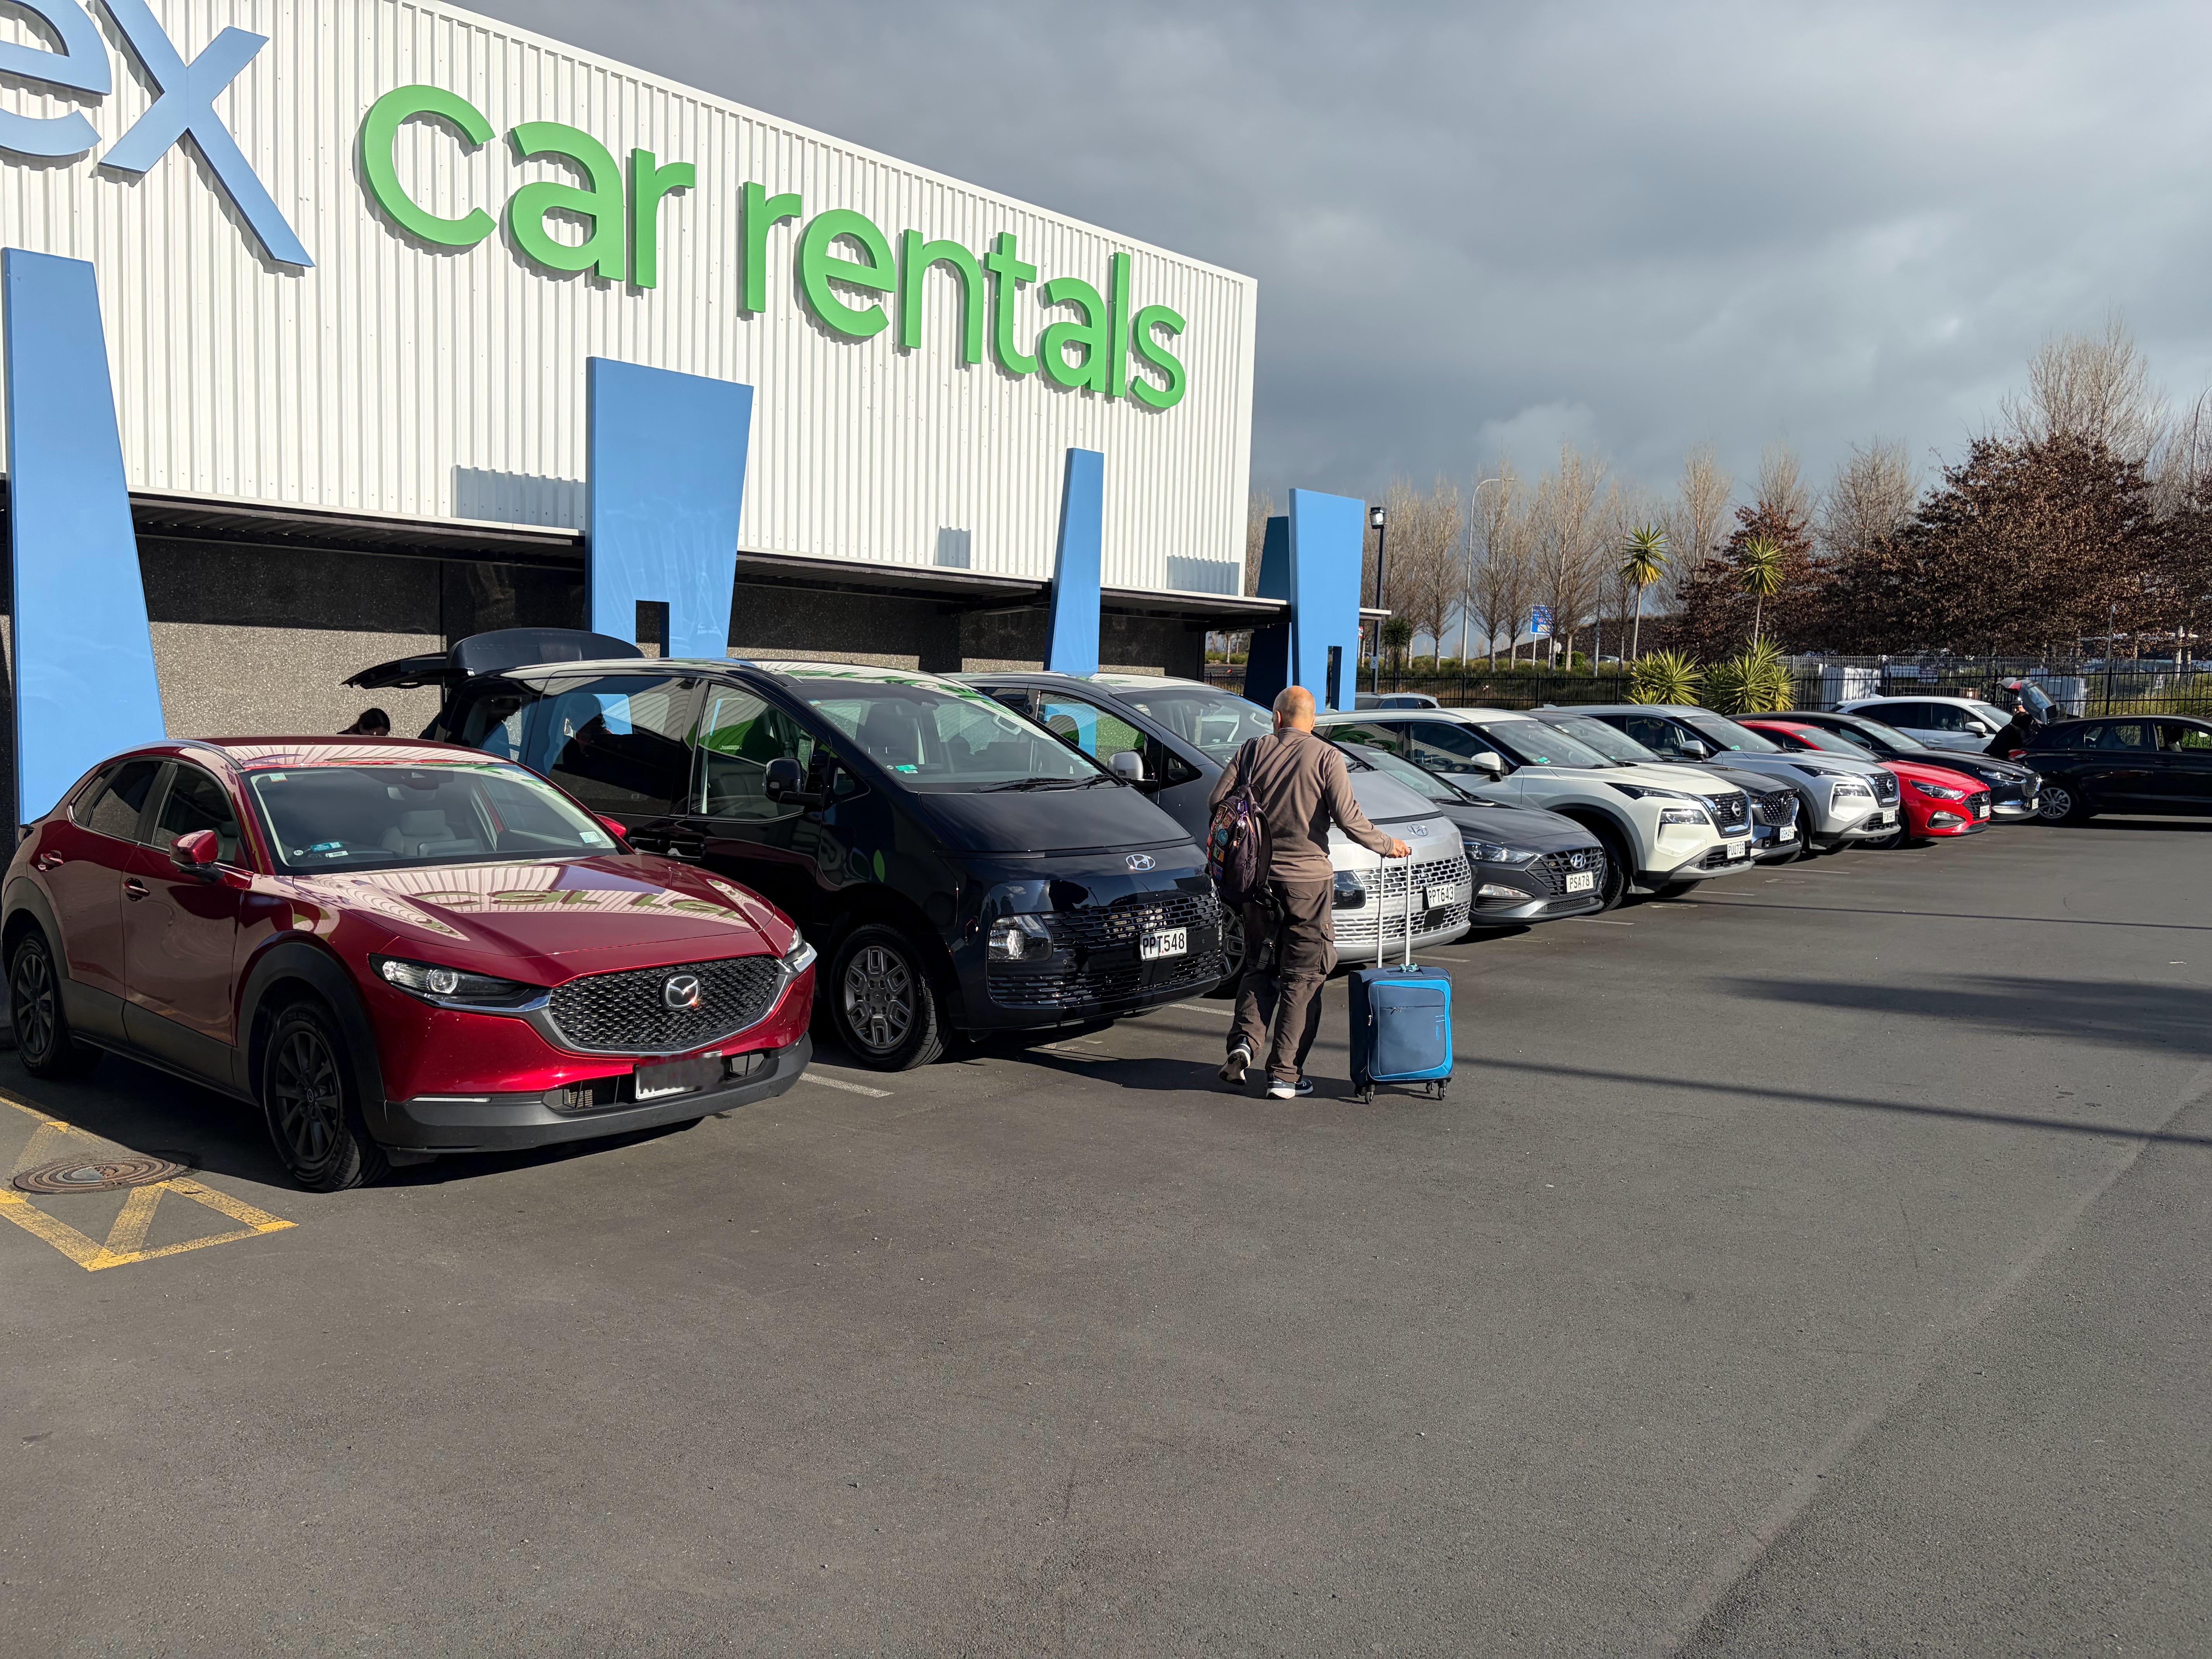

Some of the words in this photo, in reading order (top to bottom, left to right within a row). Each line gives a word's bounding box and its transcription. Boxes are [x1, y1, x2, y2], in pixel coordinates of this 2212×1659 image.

[361, 85, 696, 289] car
[743, 181, 1186, 409] rentals
[1429, 886, 1453, 905] PPT643
[1143, 933, 1185, 955] PPT548
